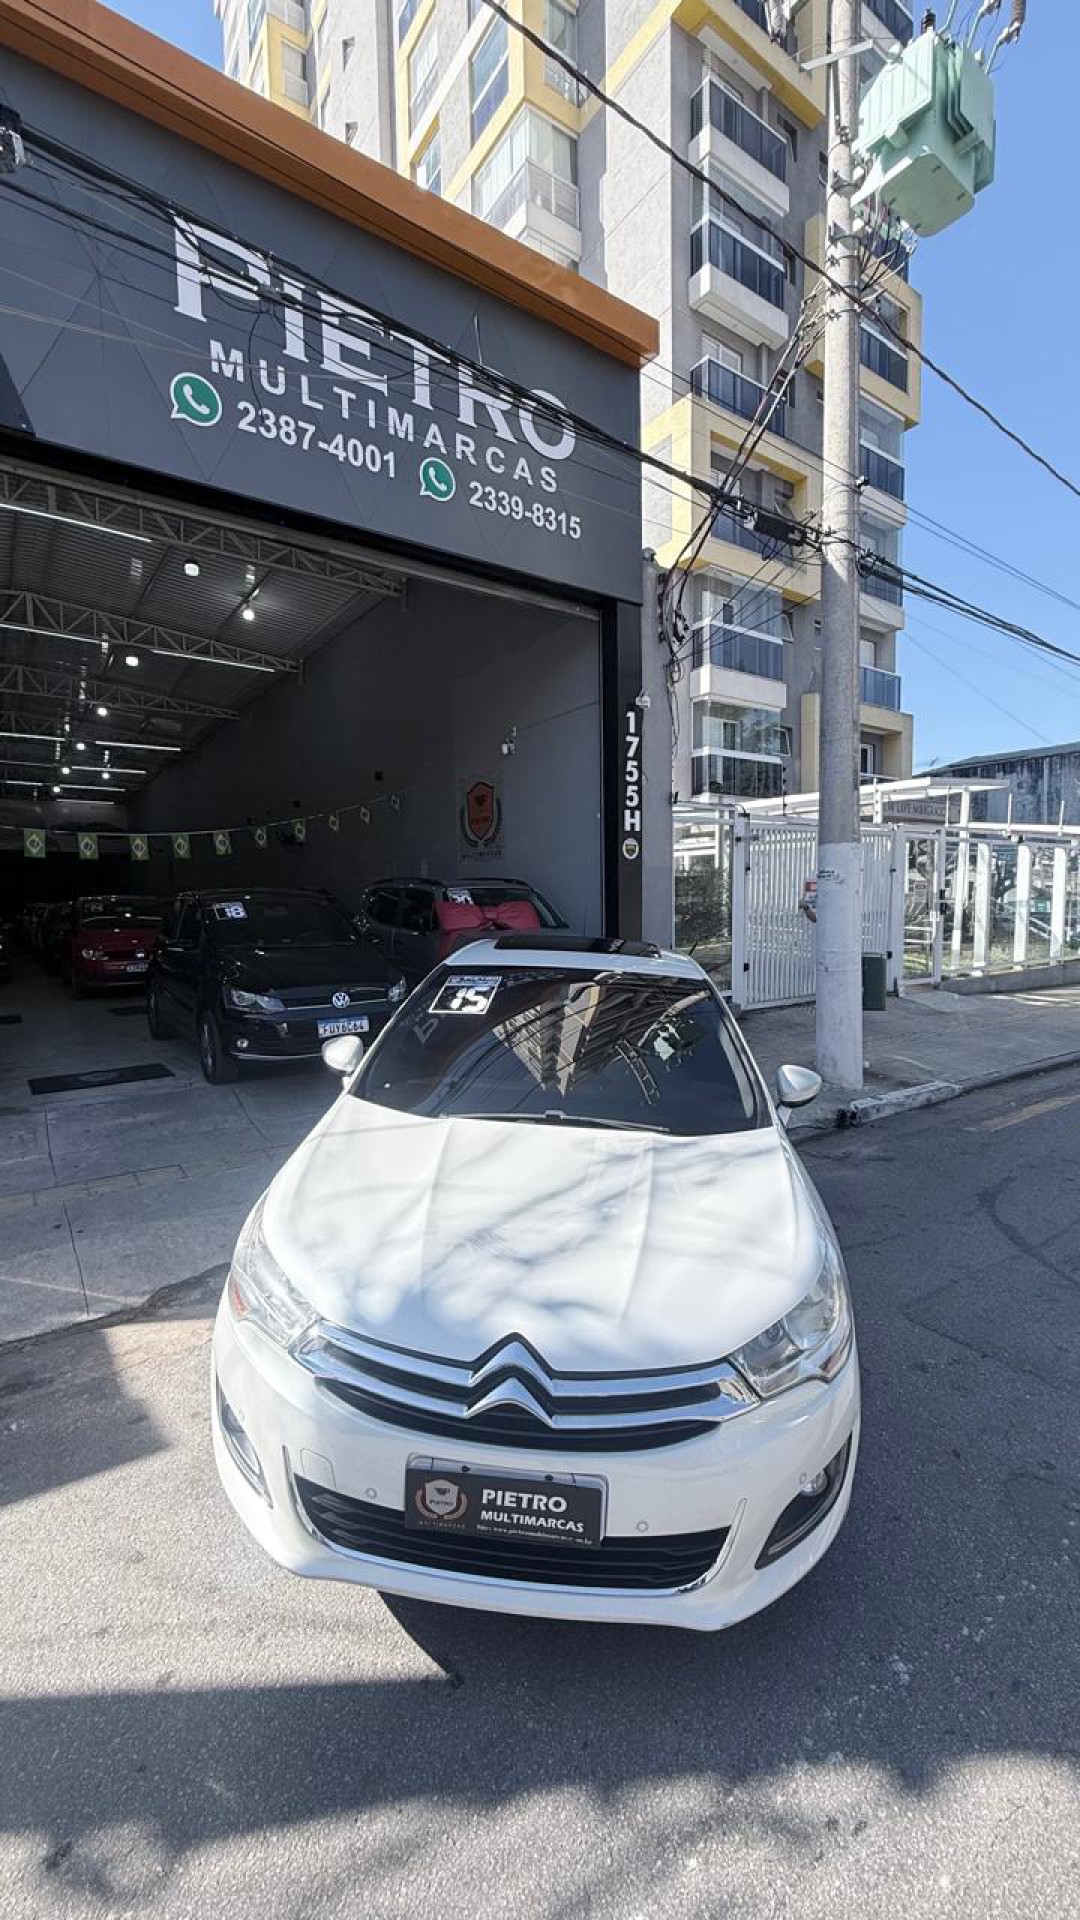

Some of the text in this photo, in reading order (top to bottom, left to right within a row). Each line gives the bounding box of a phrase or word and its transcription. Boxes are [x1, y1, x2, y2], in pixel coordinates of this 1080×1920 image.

[174, 215, 576, 460] PIETRO
[209, 339, 558, 493] MULTIMARCAS
[237, 401, 395, 479] 2387-4001
[469, 481, 582, 539] 2339-8315
[624, 711, 641, 831] 1755H
[450, 986, 488, 1012] 15
[481, 1510, 584, 1533] MULTIMARCAS
[482, 1488, 567, 1513] PIETRO
